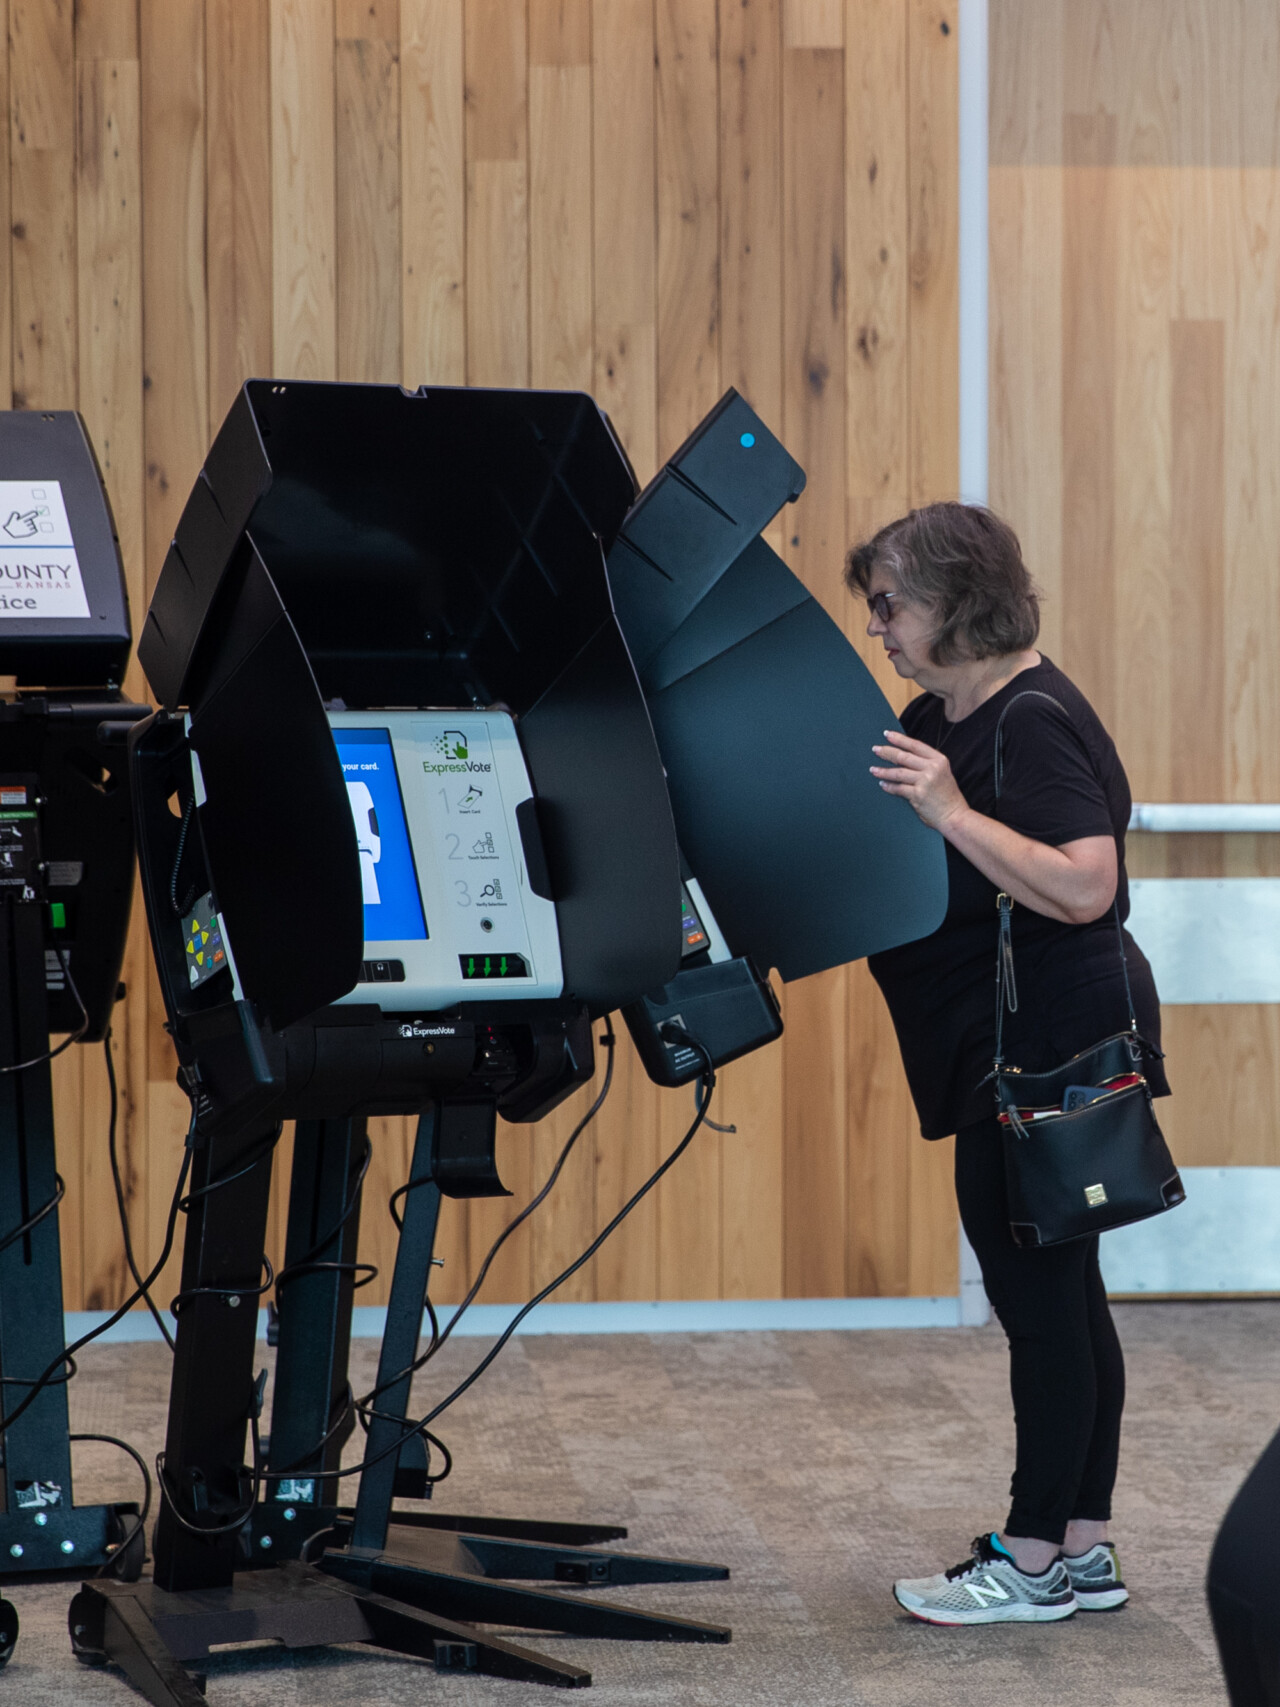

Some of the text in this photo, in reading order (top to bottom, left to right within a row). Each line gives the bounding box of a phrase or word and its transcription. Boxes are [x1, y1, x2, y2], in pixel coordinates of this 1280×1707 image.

[0, 564, 71, 579] UNTY
[15, 581, 71, 590] KANSAS
[422, 761, 491, 776] ExpressVote
[445, 833, 464, 860] 2
[454, 880, 472, 907] 3
[413, 1027, 455, 1037] ExpressVote
